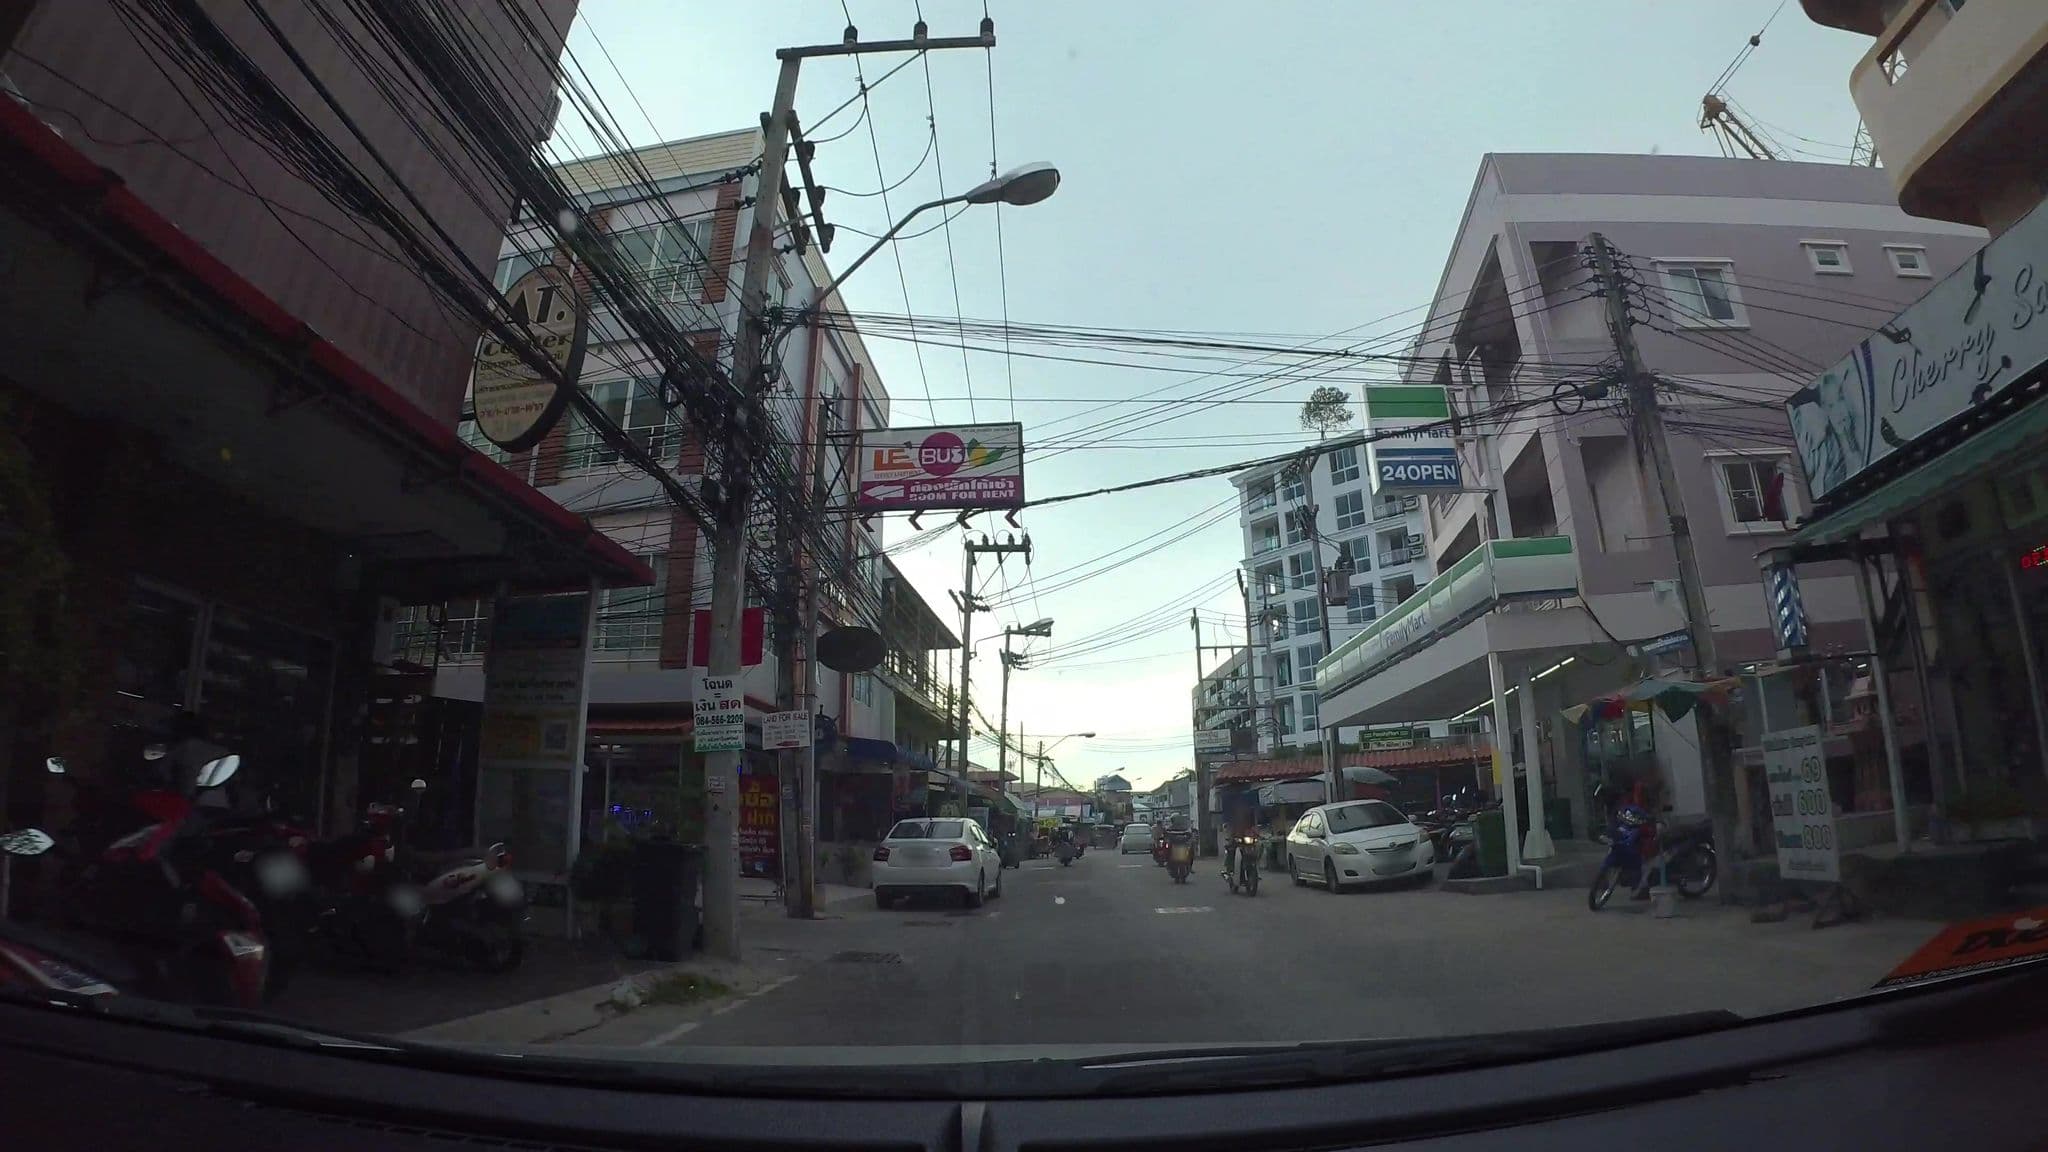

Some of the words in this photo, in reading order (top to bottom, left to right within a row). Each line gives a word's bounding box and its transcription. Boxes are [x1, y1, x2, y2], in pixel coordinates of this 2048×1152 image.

[1890, 321, 1996, 414] Cherry
[951, 490, 977, 500] FOR
[982, 489, 1016, 499] RENT
[1384, 609, 1427, 648] FamilyMart
[778, 713, 791, 722] FOR
